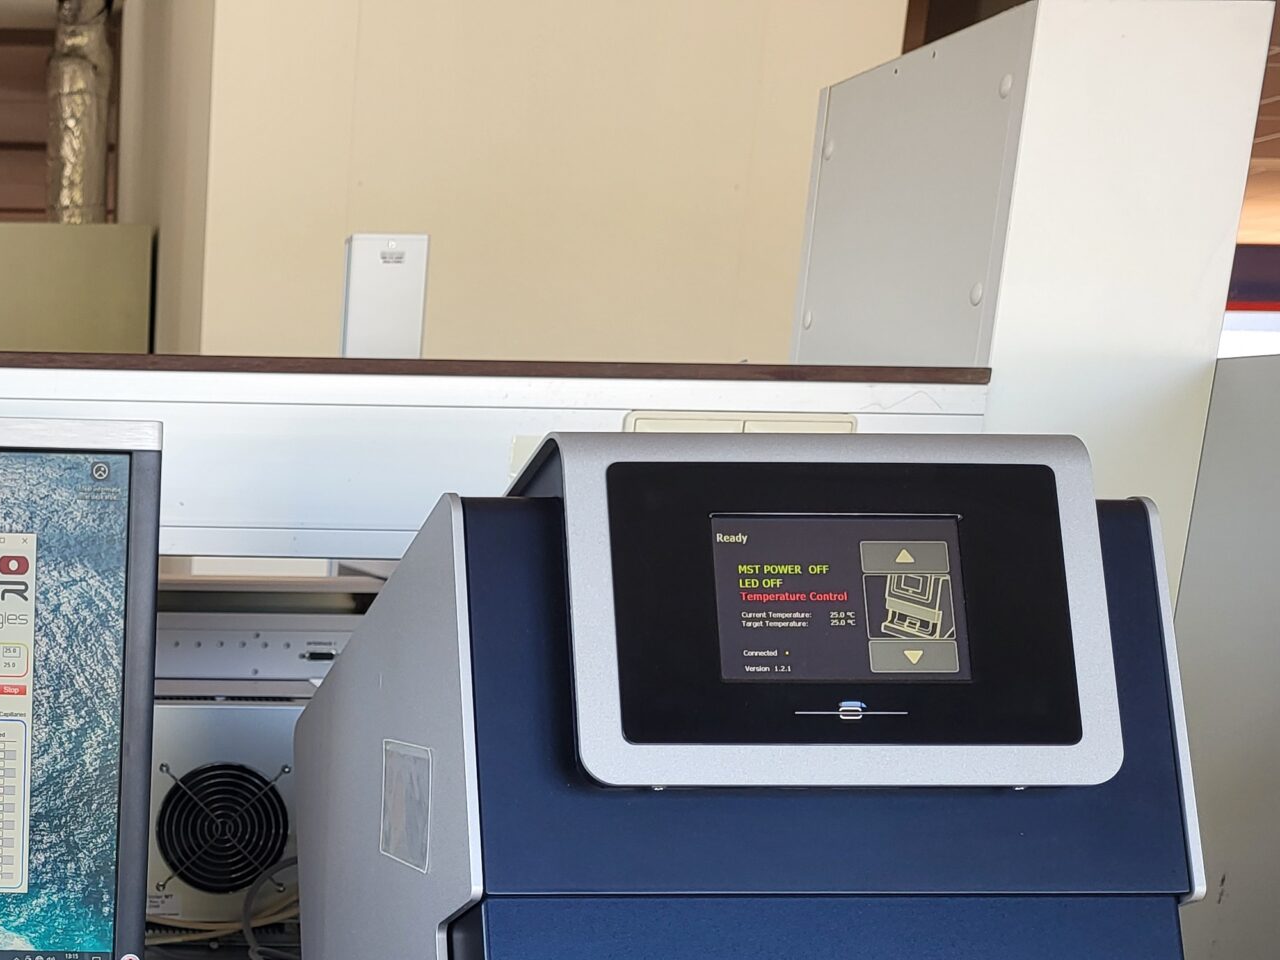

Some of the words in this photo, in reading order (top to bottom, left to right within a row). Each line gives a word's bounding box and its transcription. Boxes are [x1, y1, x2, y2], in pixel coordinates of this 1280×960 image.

[716, 533, 748, 544] Ready
[738, 565, 760, 574] MST
[764, 565, 802, 574] POWER
[808, 565, 829, 574] OFF
[739, 579, 759, 588] LED
[762, 579, 782, 588] OFF
[740, 592, 806, 602] Temperature
[810, 592, 848, 601] Control
[3, 686, 19, 694] Stop
